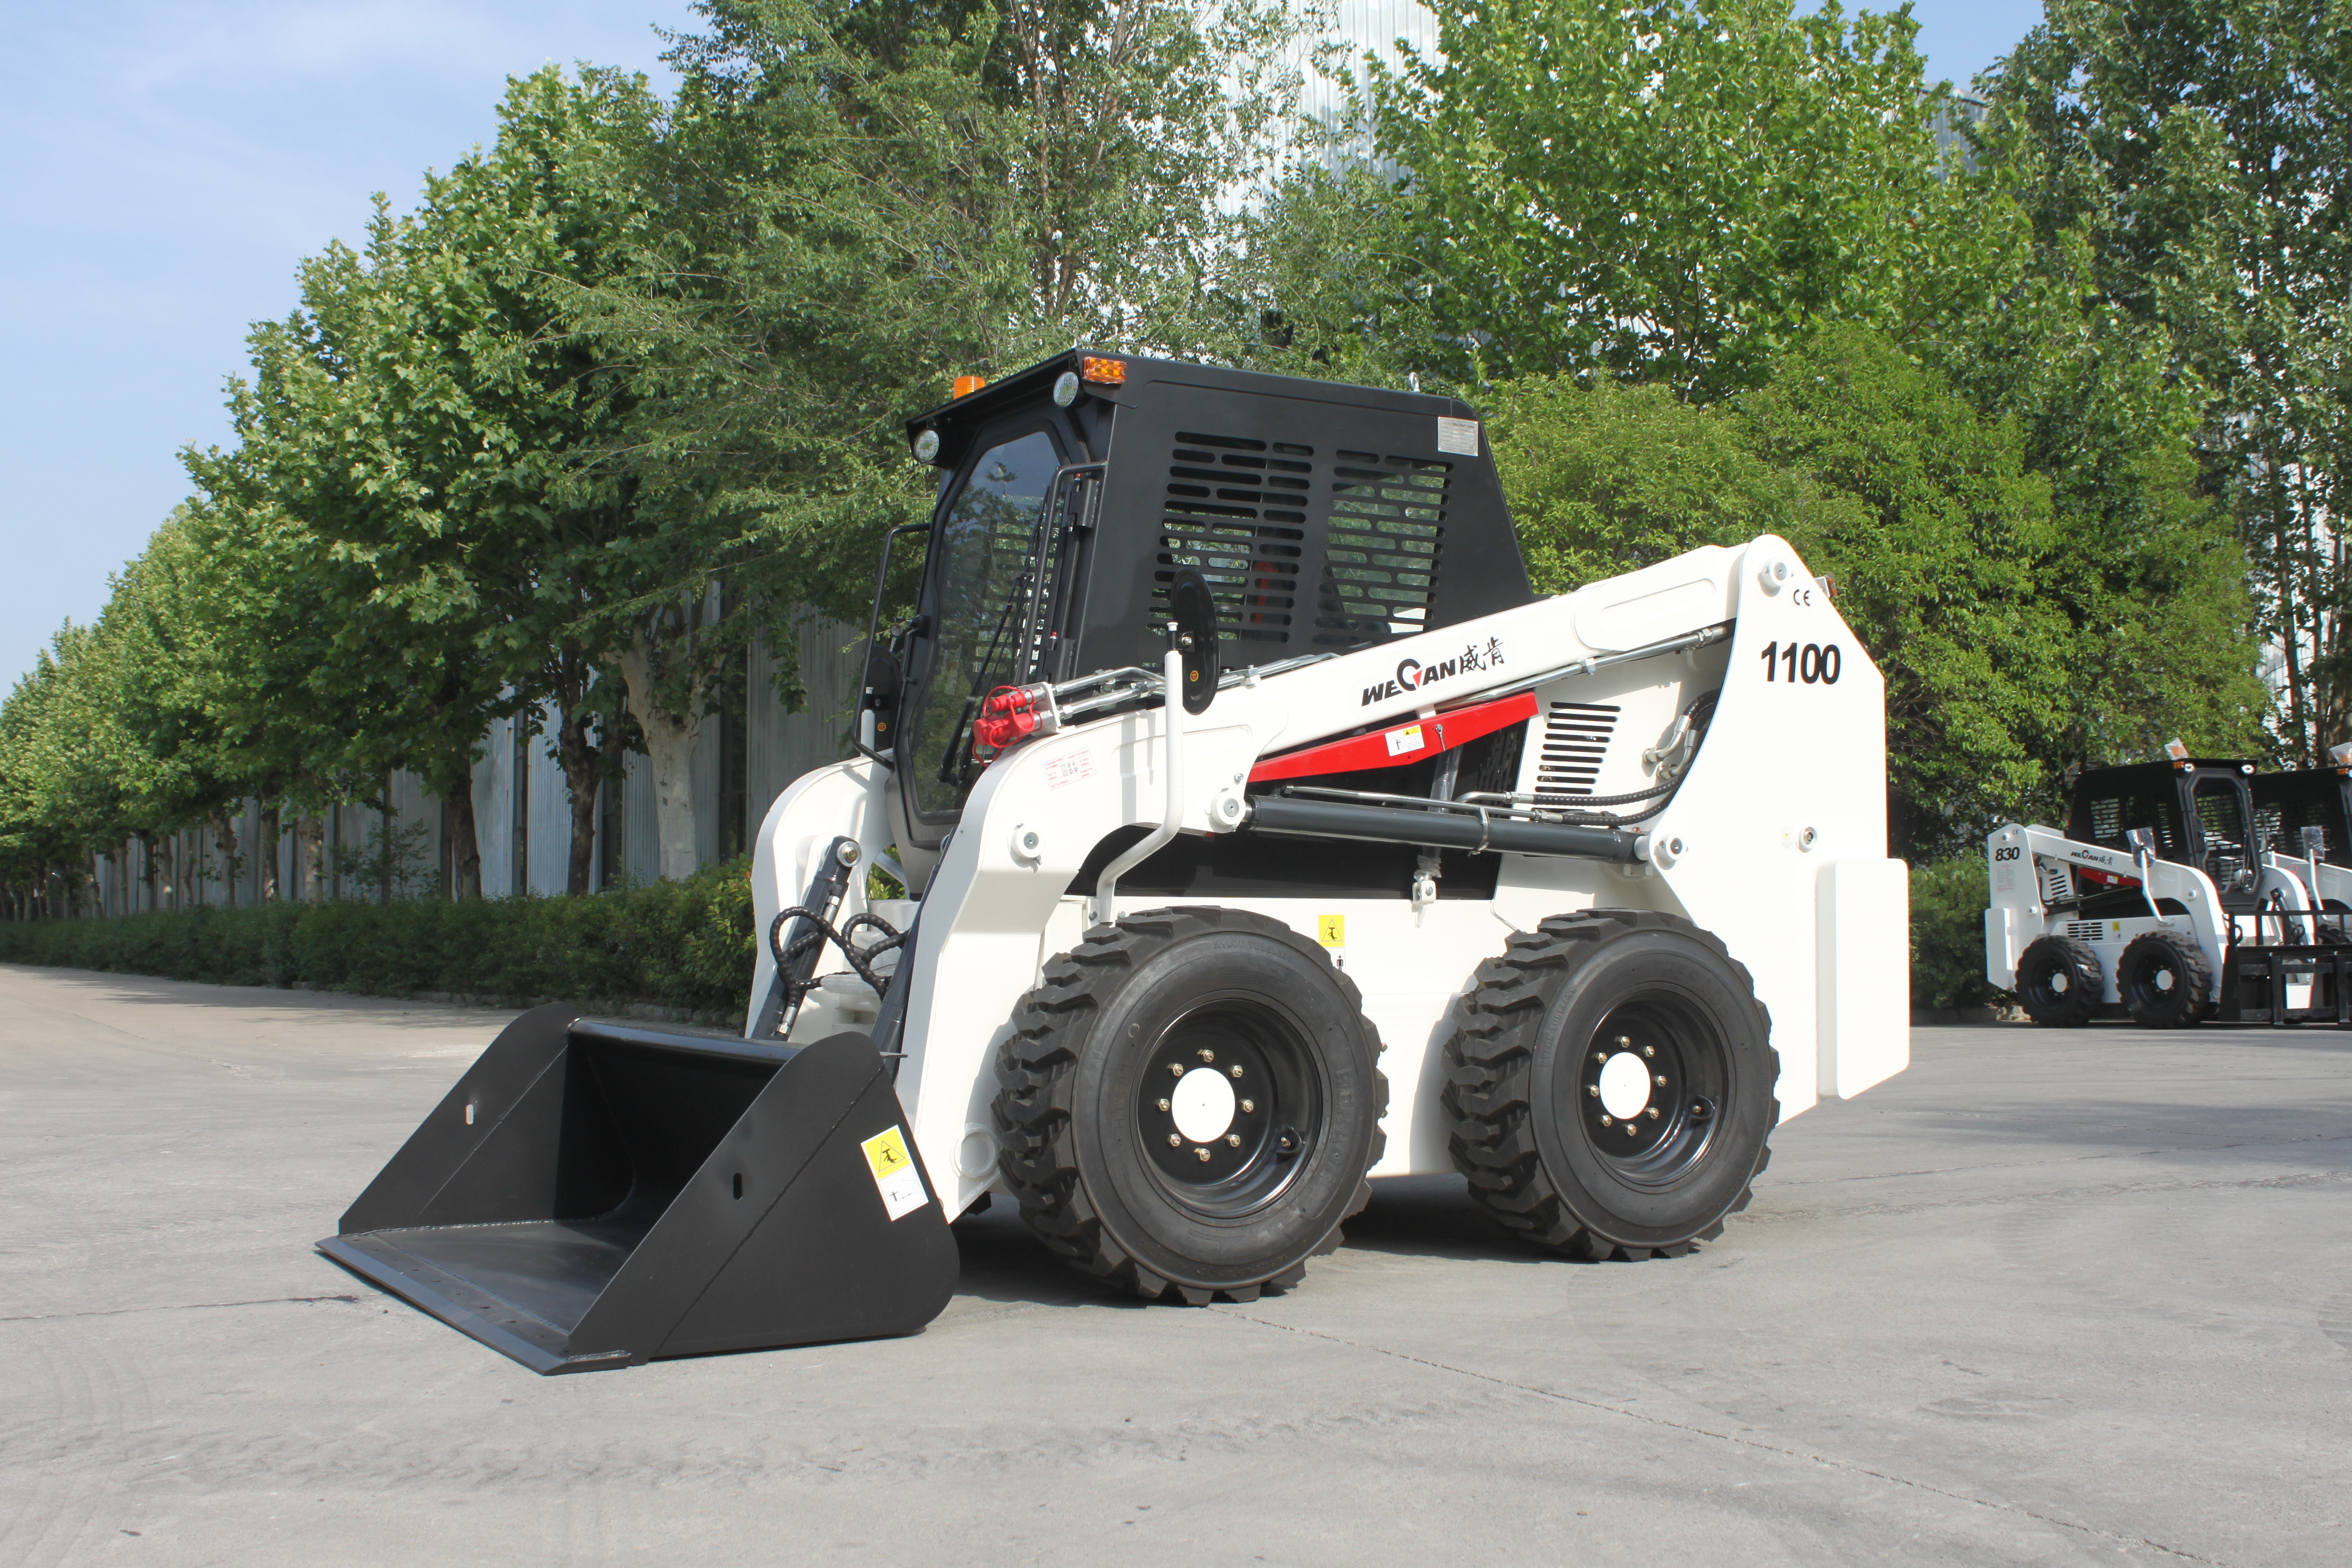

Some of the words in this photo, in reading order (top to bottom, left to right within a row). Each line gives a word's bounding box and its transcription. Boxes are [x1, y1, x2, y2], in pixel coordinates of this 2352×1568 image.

[1793, 589, 1811, 606] CE
[1460, 637, 1504, 675] 威肯
[1761, 641, 1841, 685] 1100
[1995, 847, 2020, 861] 830
[1213, 940, 1245, 949] NYLON
[1247, 941, 1292, 963] TUBELESS
